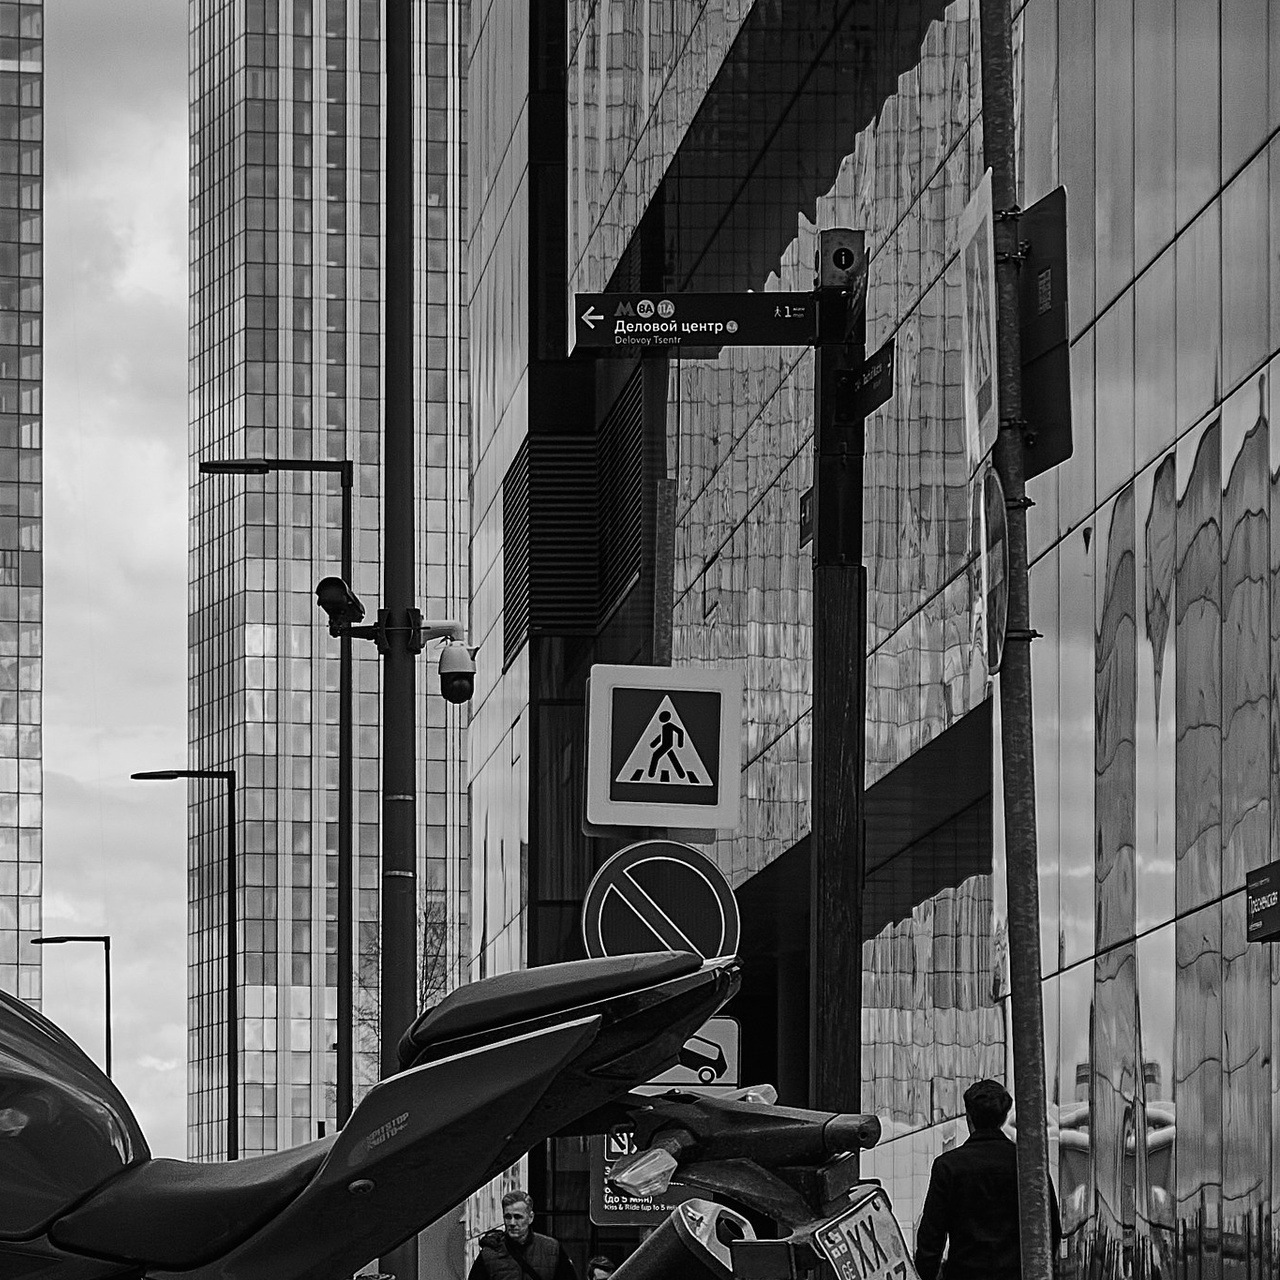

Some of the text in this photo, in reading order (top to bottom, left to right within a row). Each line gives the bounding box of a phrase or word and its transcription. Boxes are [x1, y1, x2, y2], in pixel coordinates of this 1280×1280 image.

[614, 320, 724, 335] Деловой центр
[615, 335, 682, 346] Delovoy Tsentr
[846, 1214, 889, 1280] XX
